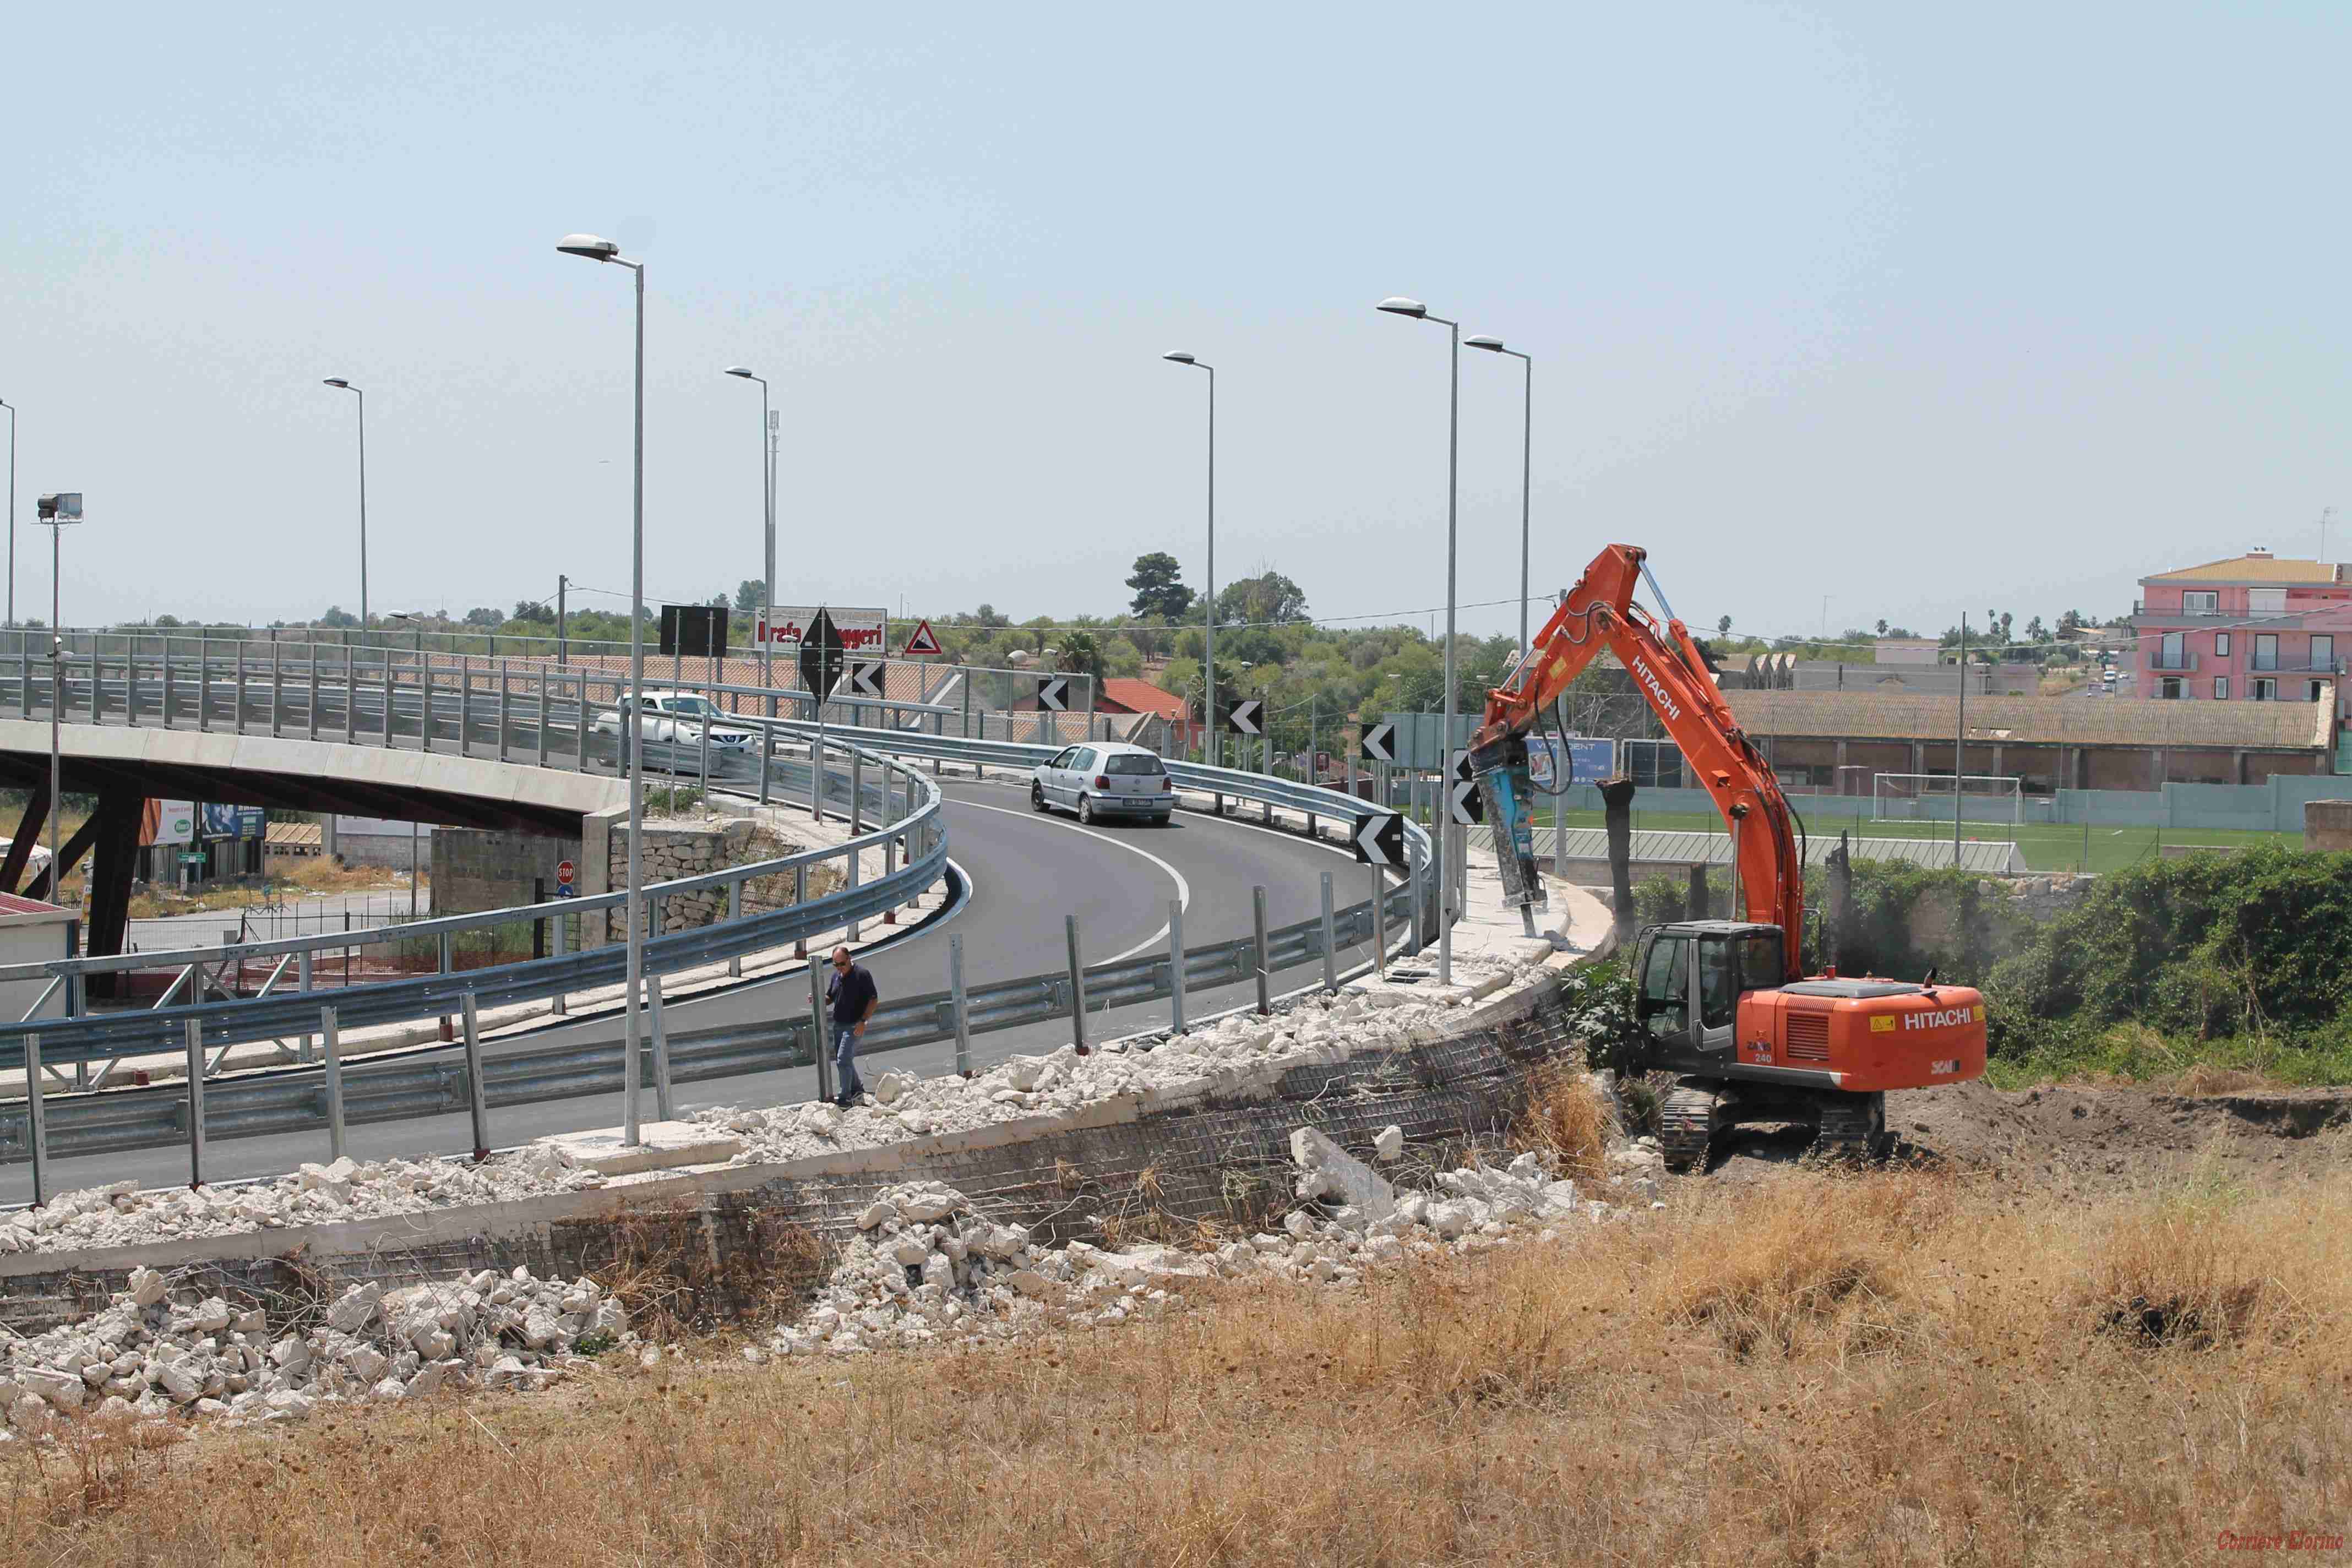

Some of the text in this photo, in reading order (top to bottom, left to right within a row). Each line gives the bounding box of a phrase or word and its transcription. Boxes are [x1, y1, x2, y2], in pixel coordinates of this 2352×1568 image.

[1632, 655, 1681, 721] HITACHI
[559, 868, 573, 877] STOP
[1904, 1008, 1971, 1030] HITACHI
